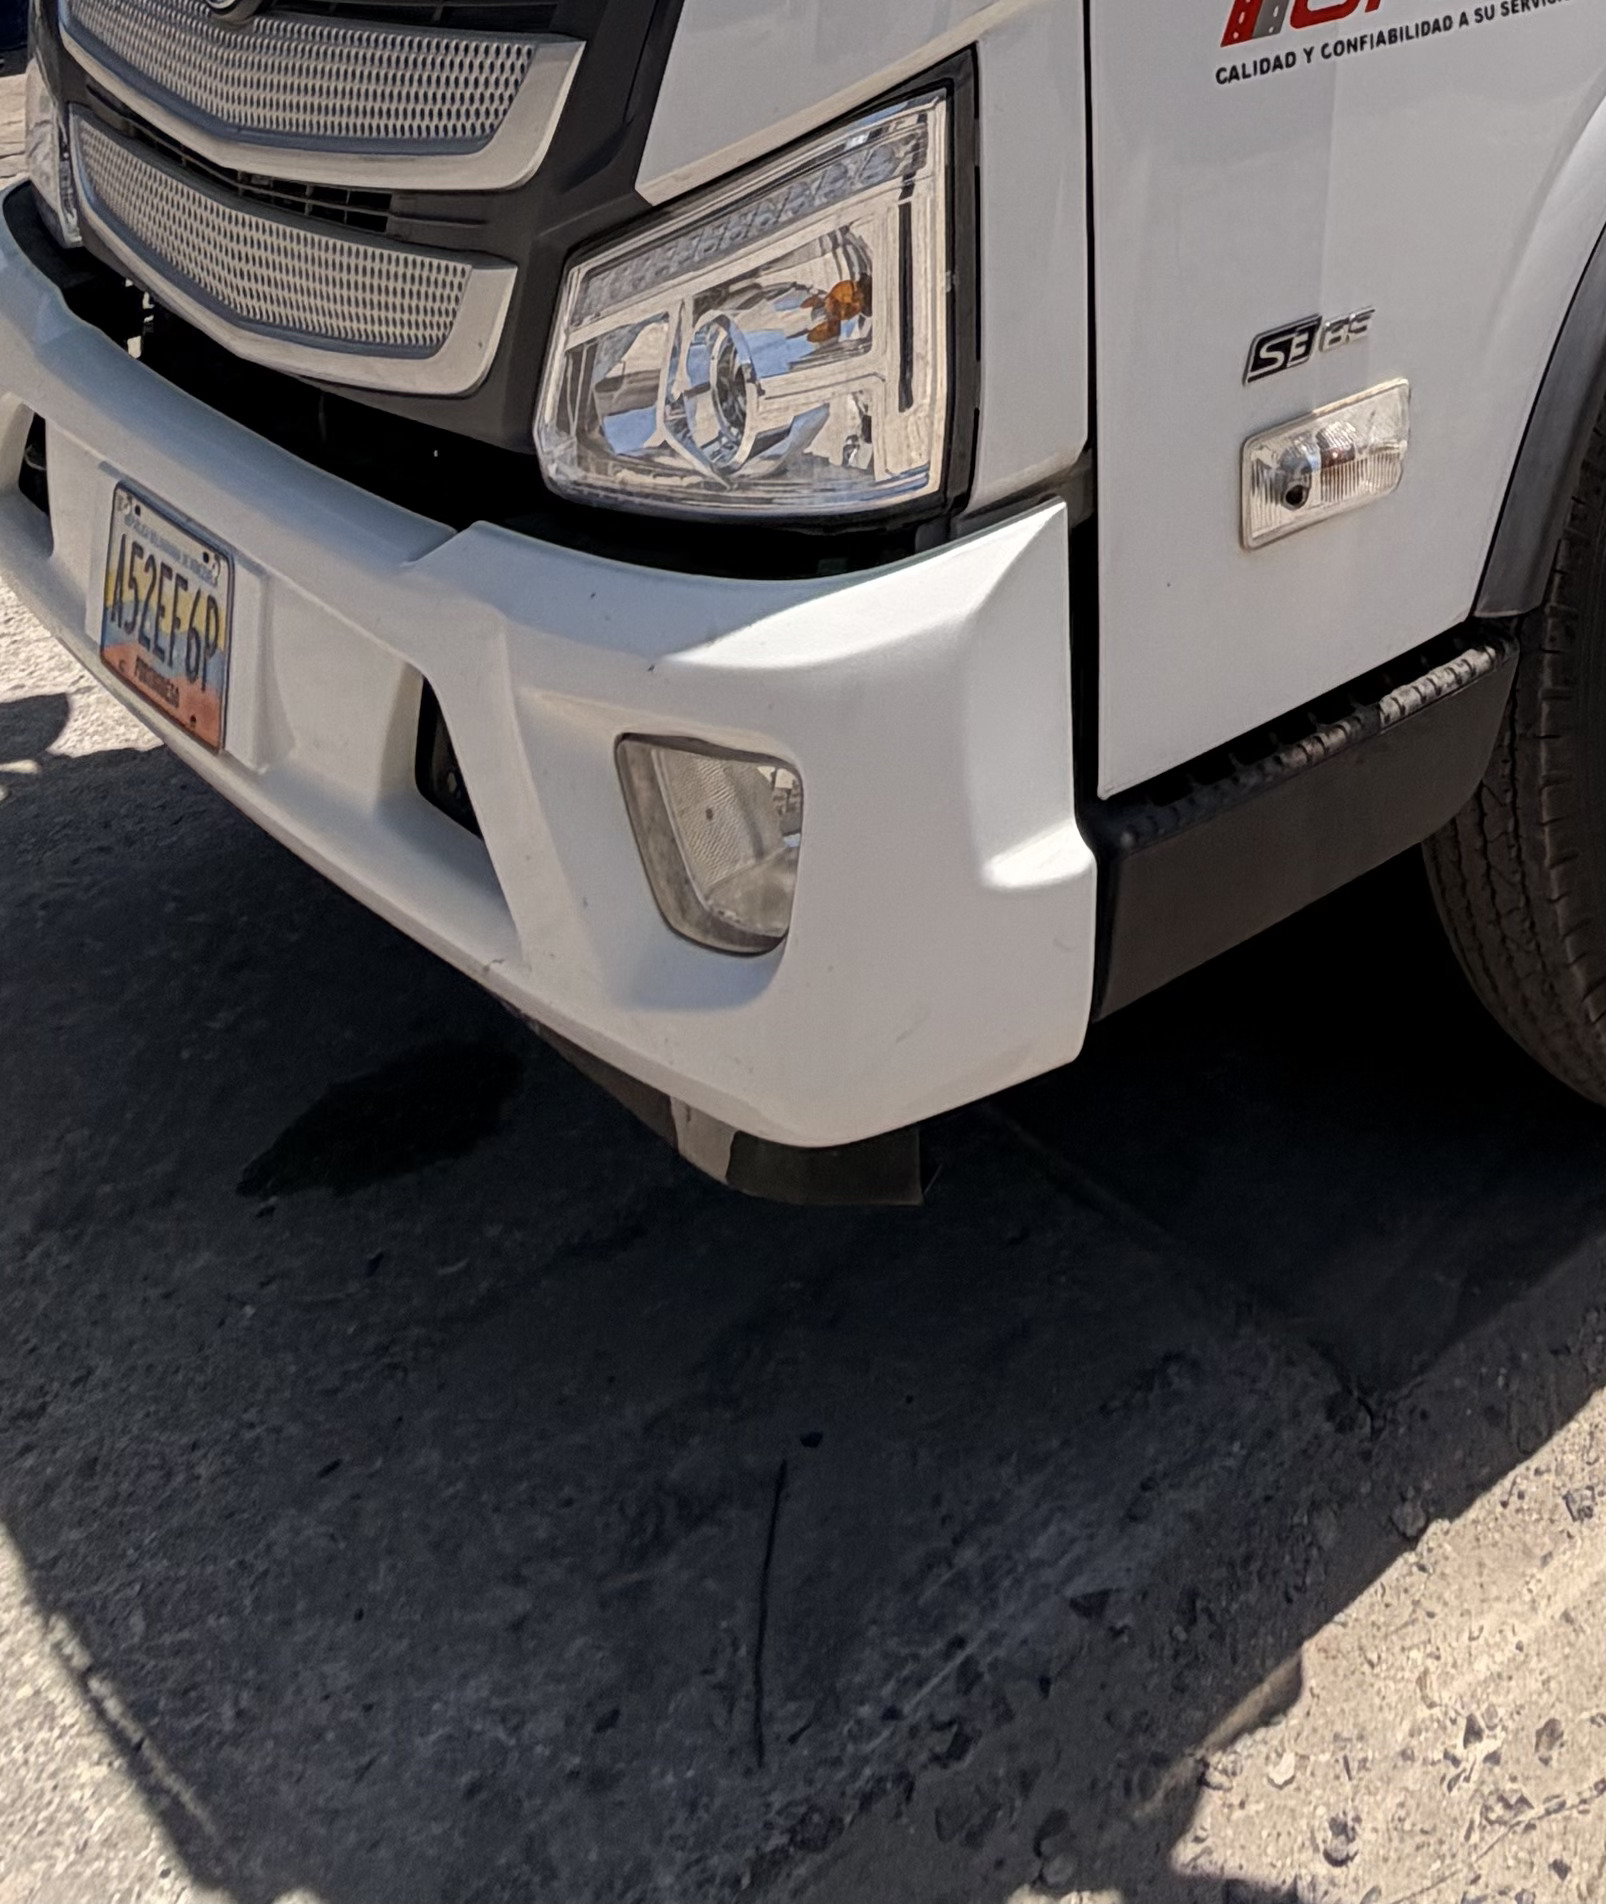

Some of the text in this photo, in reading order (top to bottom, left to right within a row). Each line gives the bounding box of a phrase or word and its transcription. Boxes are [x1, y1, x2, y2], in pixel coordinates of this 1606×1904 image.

[1215, 50, 1297, 85] CALIDAD
[1303, 46, 1316, 65] Y
[1320, 14, 1454, 60] CONFIABILIDAD
[1458, 11, 1471, 28] A
[1474, 4, 1496, 24] SU
[110, 533, 222, 692] A52EF6P
